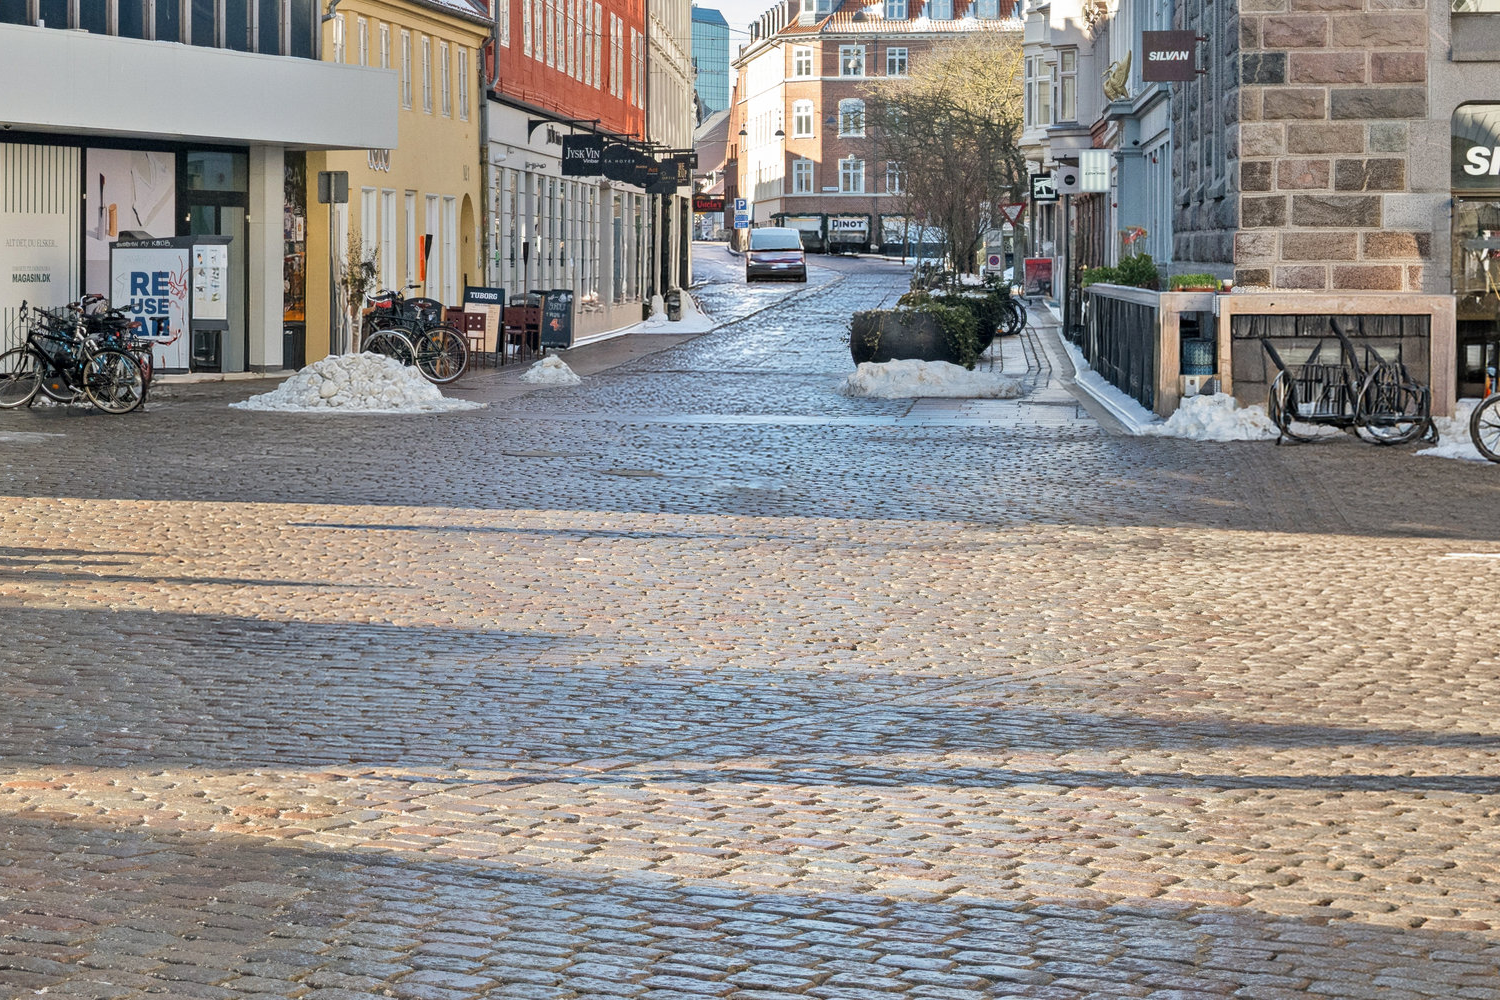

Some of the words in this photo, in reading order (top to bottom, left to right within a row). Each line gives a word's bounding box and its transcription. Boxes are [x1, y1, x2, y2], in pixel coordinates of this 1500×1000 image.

[1148, 51, 1190, 61] SILVAN
[566, 147, 585, 159] JYSK
[585, 147, 600, 159] VIN
[738, 201, 745, 209] P
[832, 219, 864, 230] PINOT
[12, 273, 51, 283] MAGASIN.DK
[130, 271, 170, 296] RE
[470, 291, 498, 300] TUBORG
[130, 298, 170, 315] USE
